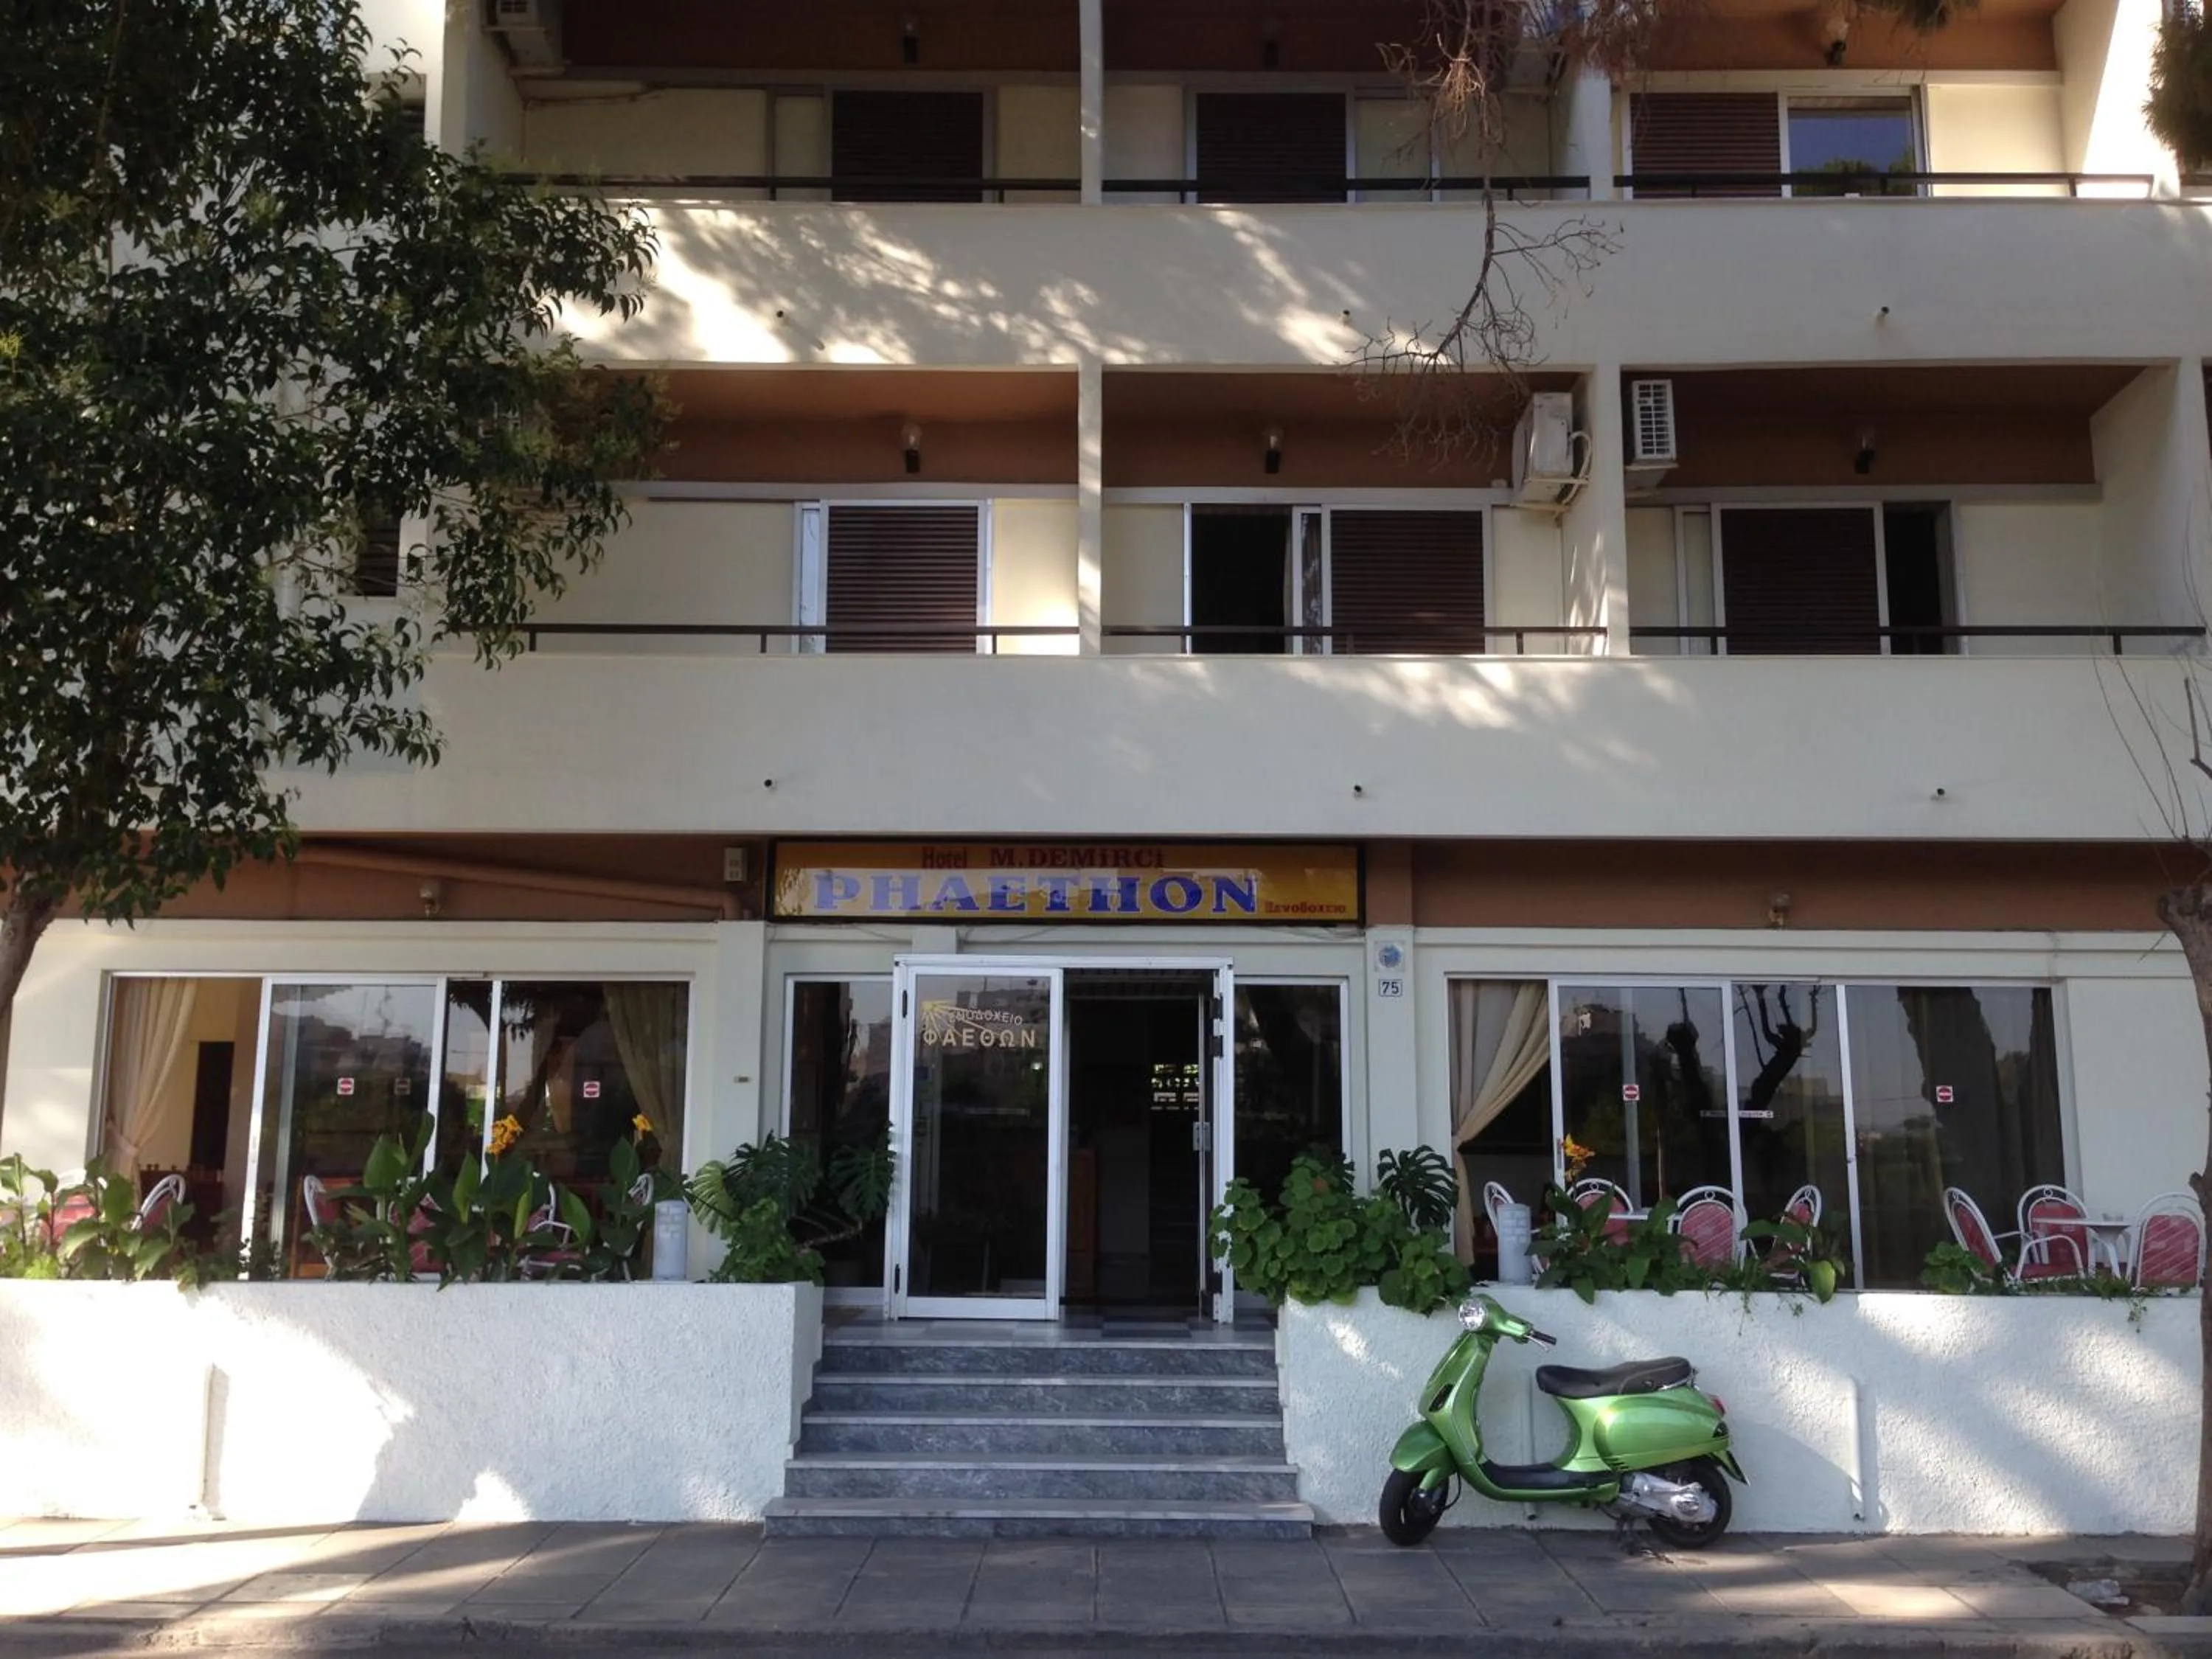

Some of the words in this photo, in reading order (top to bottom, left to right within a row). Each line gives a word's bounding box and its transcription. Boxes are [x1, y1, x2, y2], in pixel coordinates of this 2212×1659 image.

[922, 846, 968, 869] Hotel
[814, 874, 1256, 913] PHAETHON
[1382, 981, 1399, 995] 75
[922, 1029, 1035, 1048] ΦΑΕΘΩΝ
